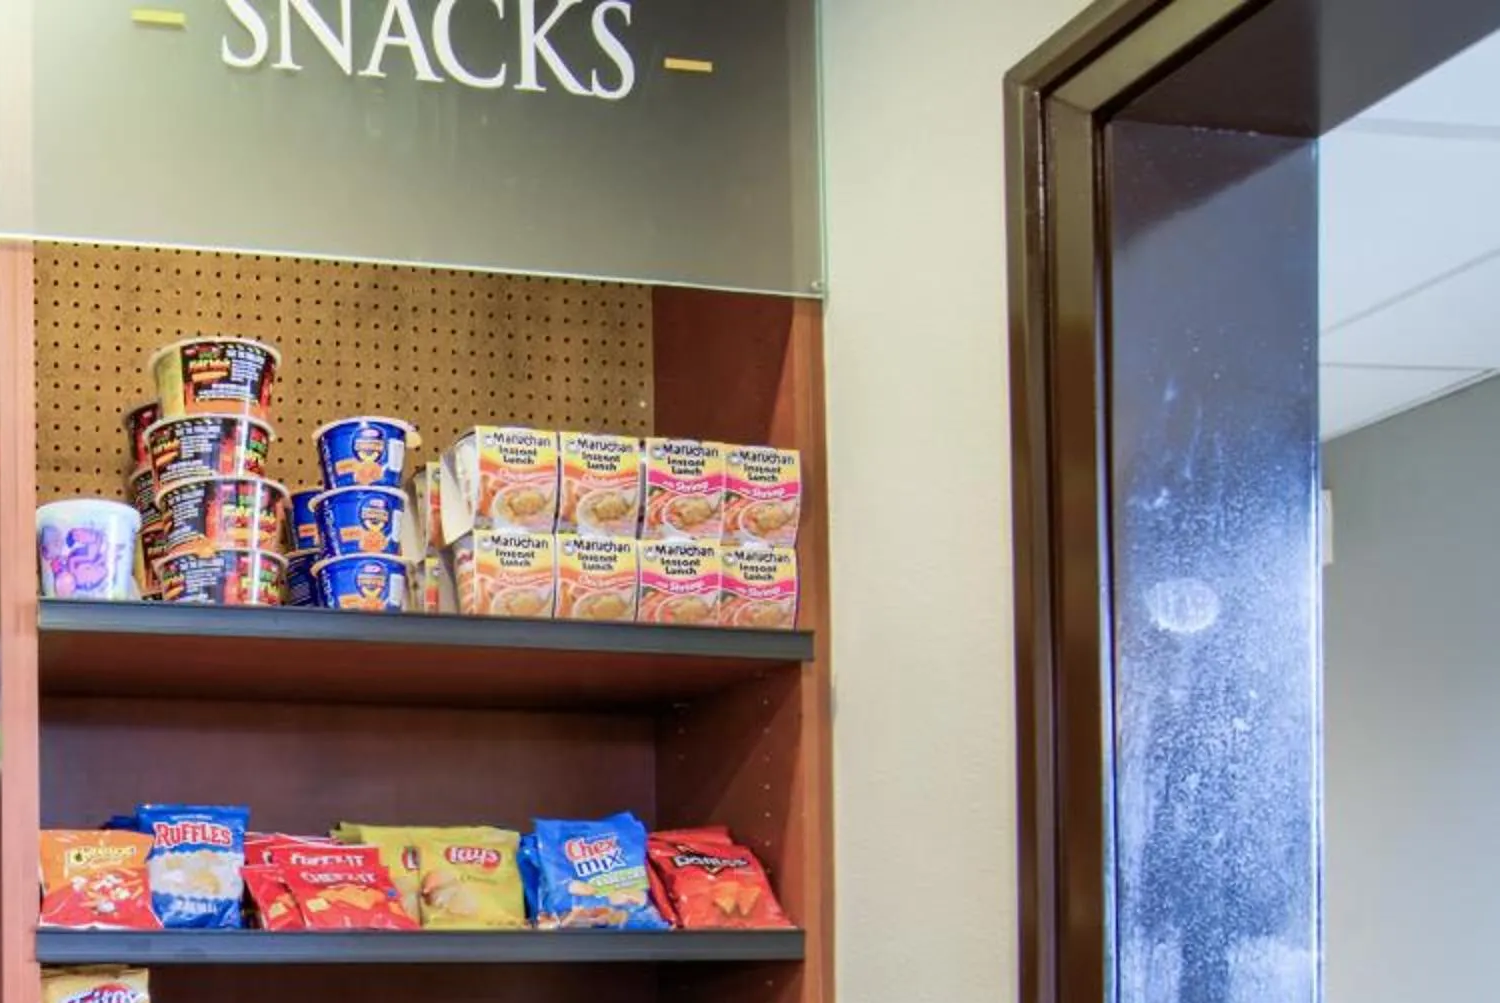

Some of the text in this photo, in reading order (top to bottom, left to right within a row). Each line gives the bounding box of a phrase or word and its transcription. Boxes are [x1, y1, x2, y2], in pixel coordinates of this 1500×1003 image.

[221, 0, 636, 99] SNACKS
[494, 432, 550, 447] Maruchan
[577, 438, 632, 452] Maruchan
[663, 443, 719, 457] Maruchan
[739, 451, 794, 465] Maruchan
[491, 535, 548, 549] Maruchan
[574, 539, 631, 553] Maruchan
[655, 544, 715, 557] Maruchan
[735, 551, 790, 563] Maruchan
[153, 821, 232, 849] RUFFLES
[564, 836, 618, 861] Chex
